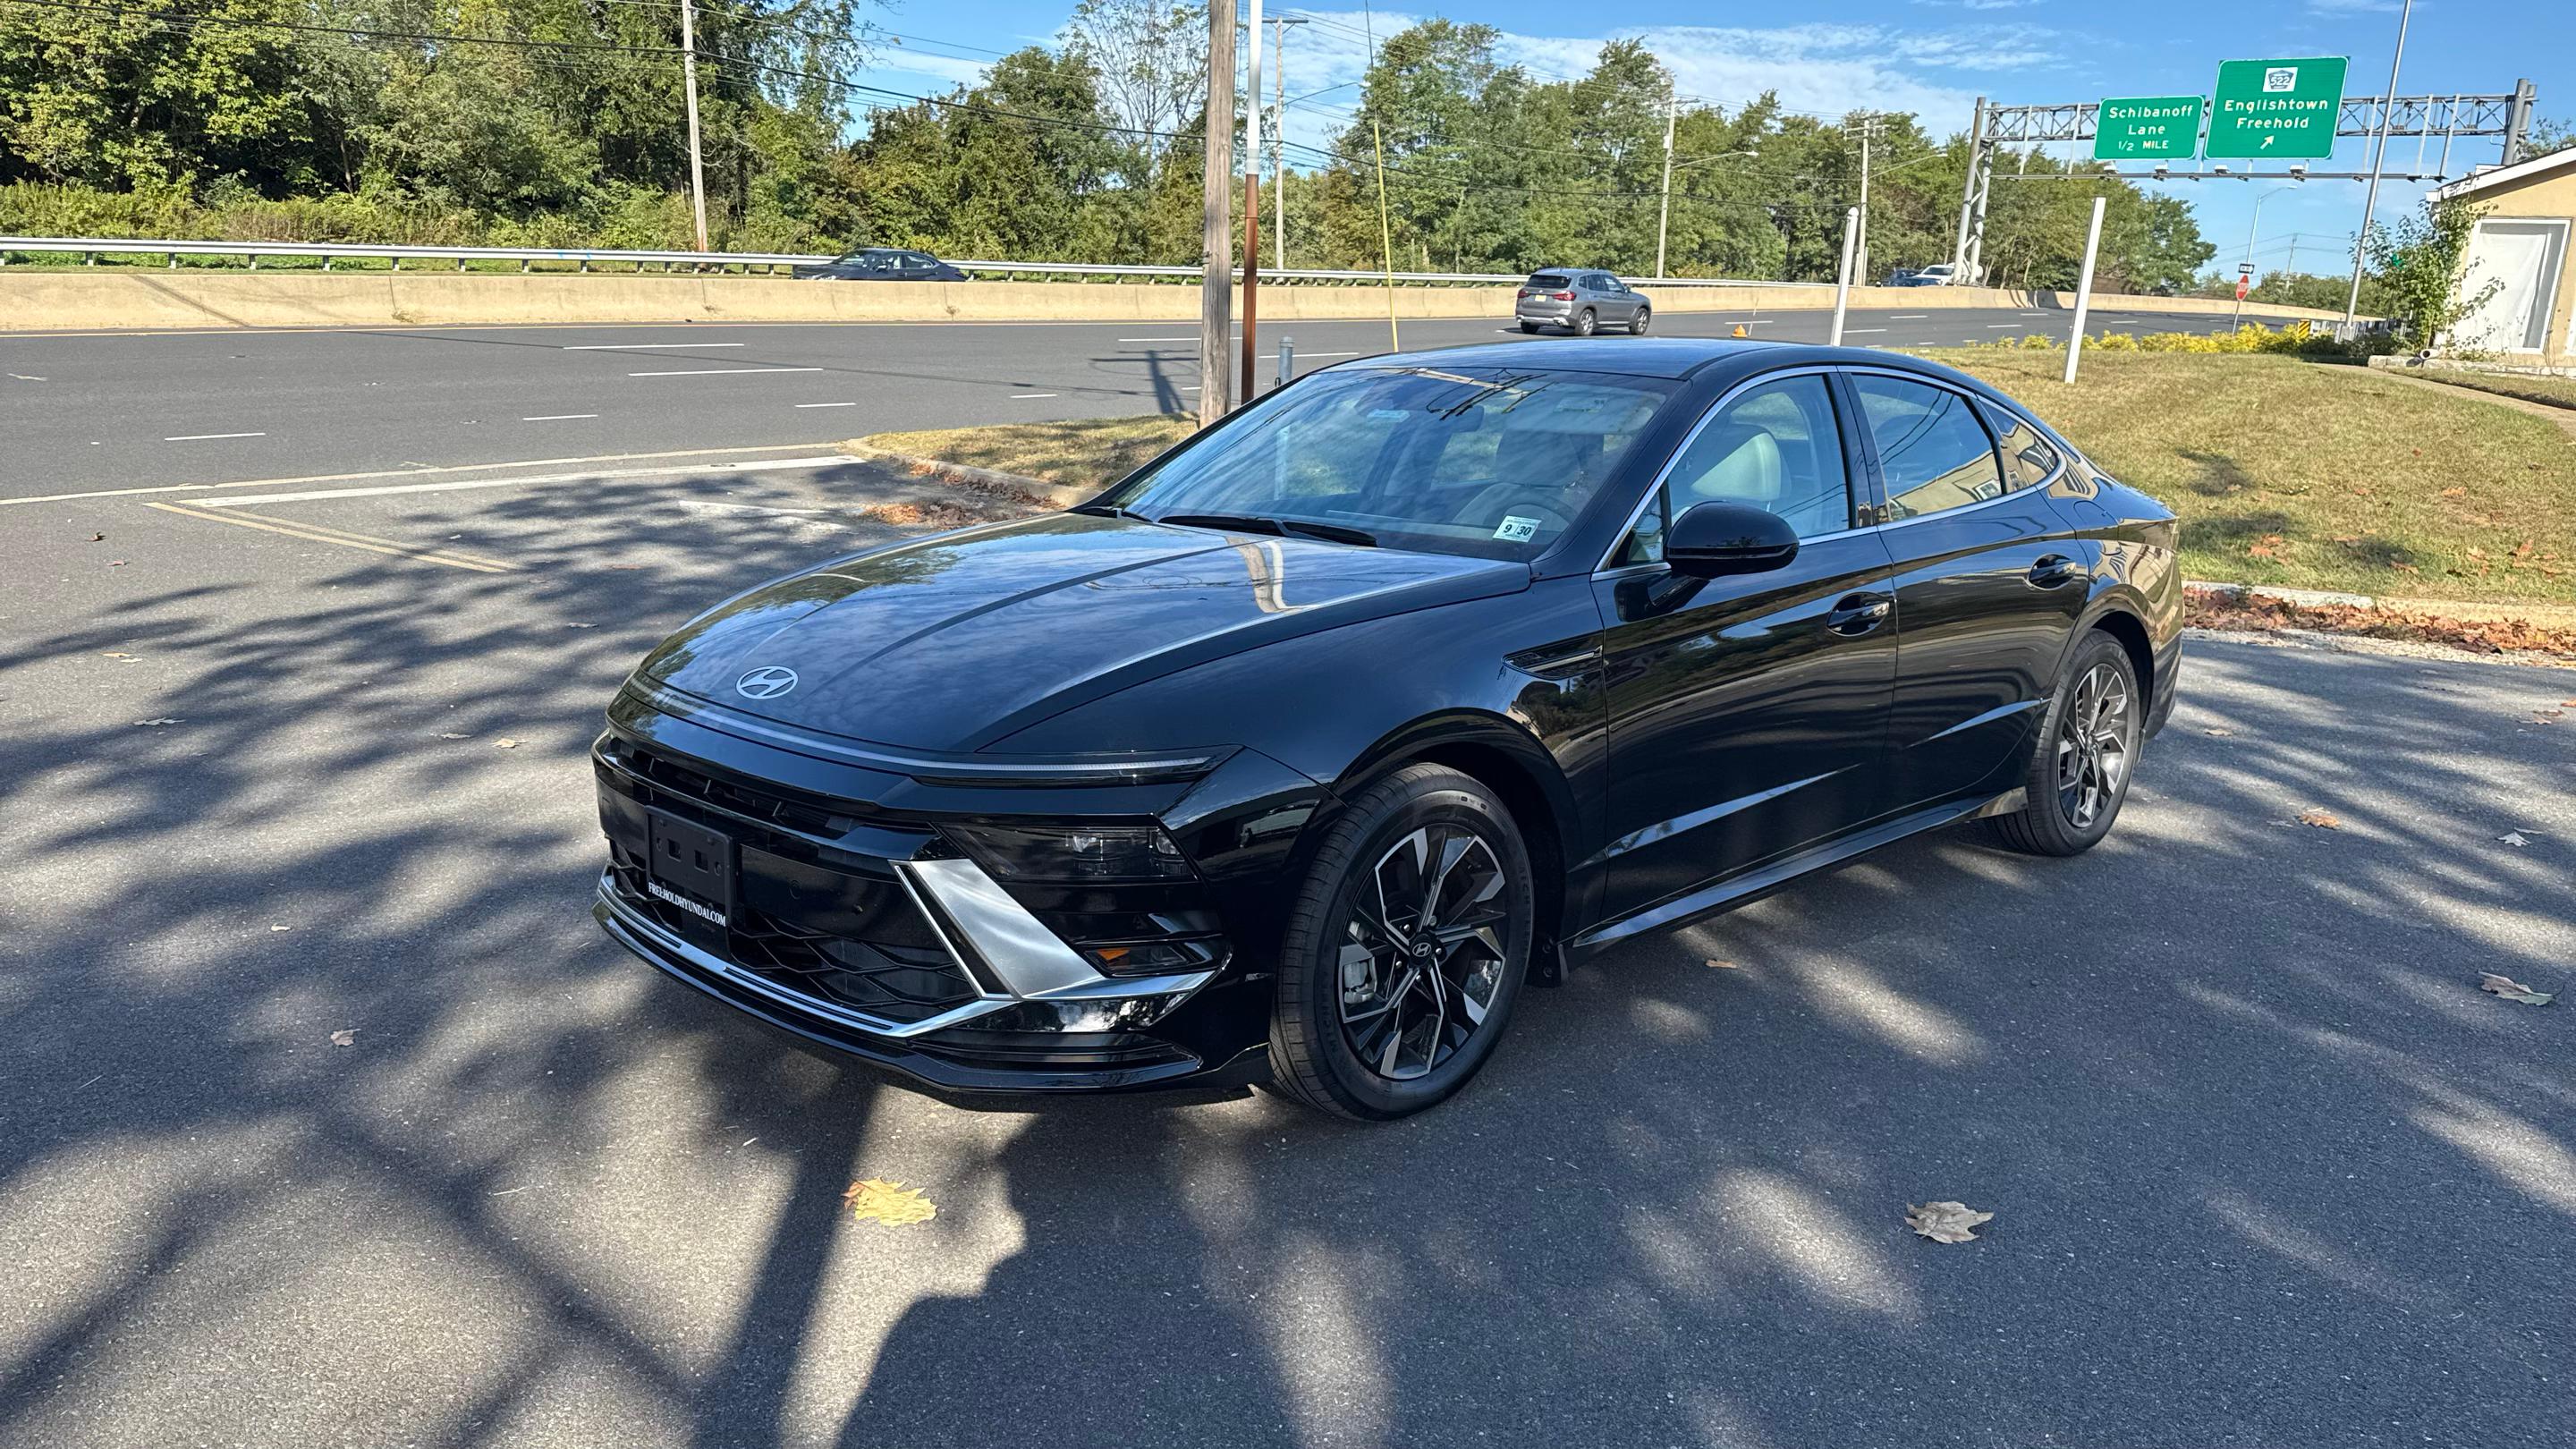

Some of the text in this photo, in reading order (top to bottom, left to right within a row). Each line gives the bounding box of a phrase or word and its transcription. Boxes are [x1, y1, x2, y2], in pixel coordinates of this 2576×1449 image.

[2270, 76, 2291, 86] 522
[2108, 105, 2193, 119] Schibanoff
[2224, 98, 2328, 114] Englishtown
[2236, 117, 2309, 129] Freehold
[2127, 124, 2165, 135] Lane
[2118, 140, 2169, 151] 1/2 MILE
[1504, 524, 1513, 533] 9
[1517, 525, 1532, 536] 30
